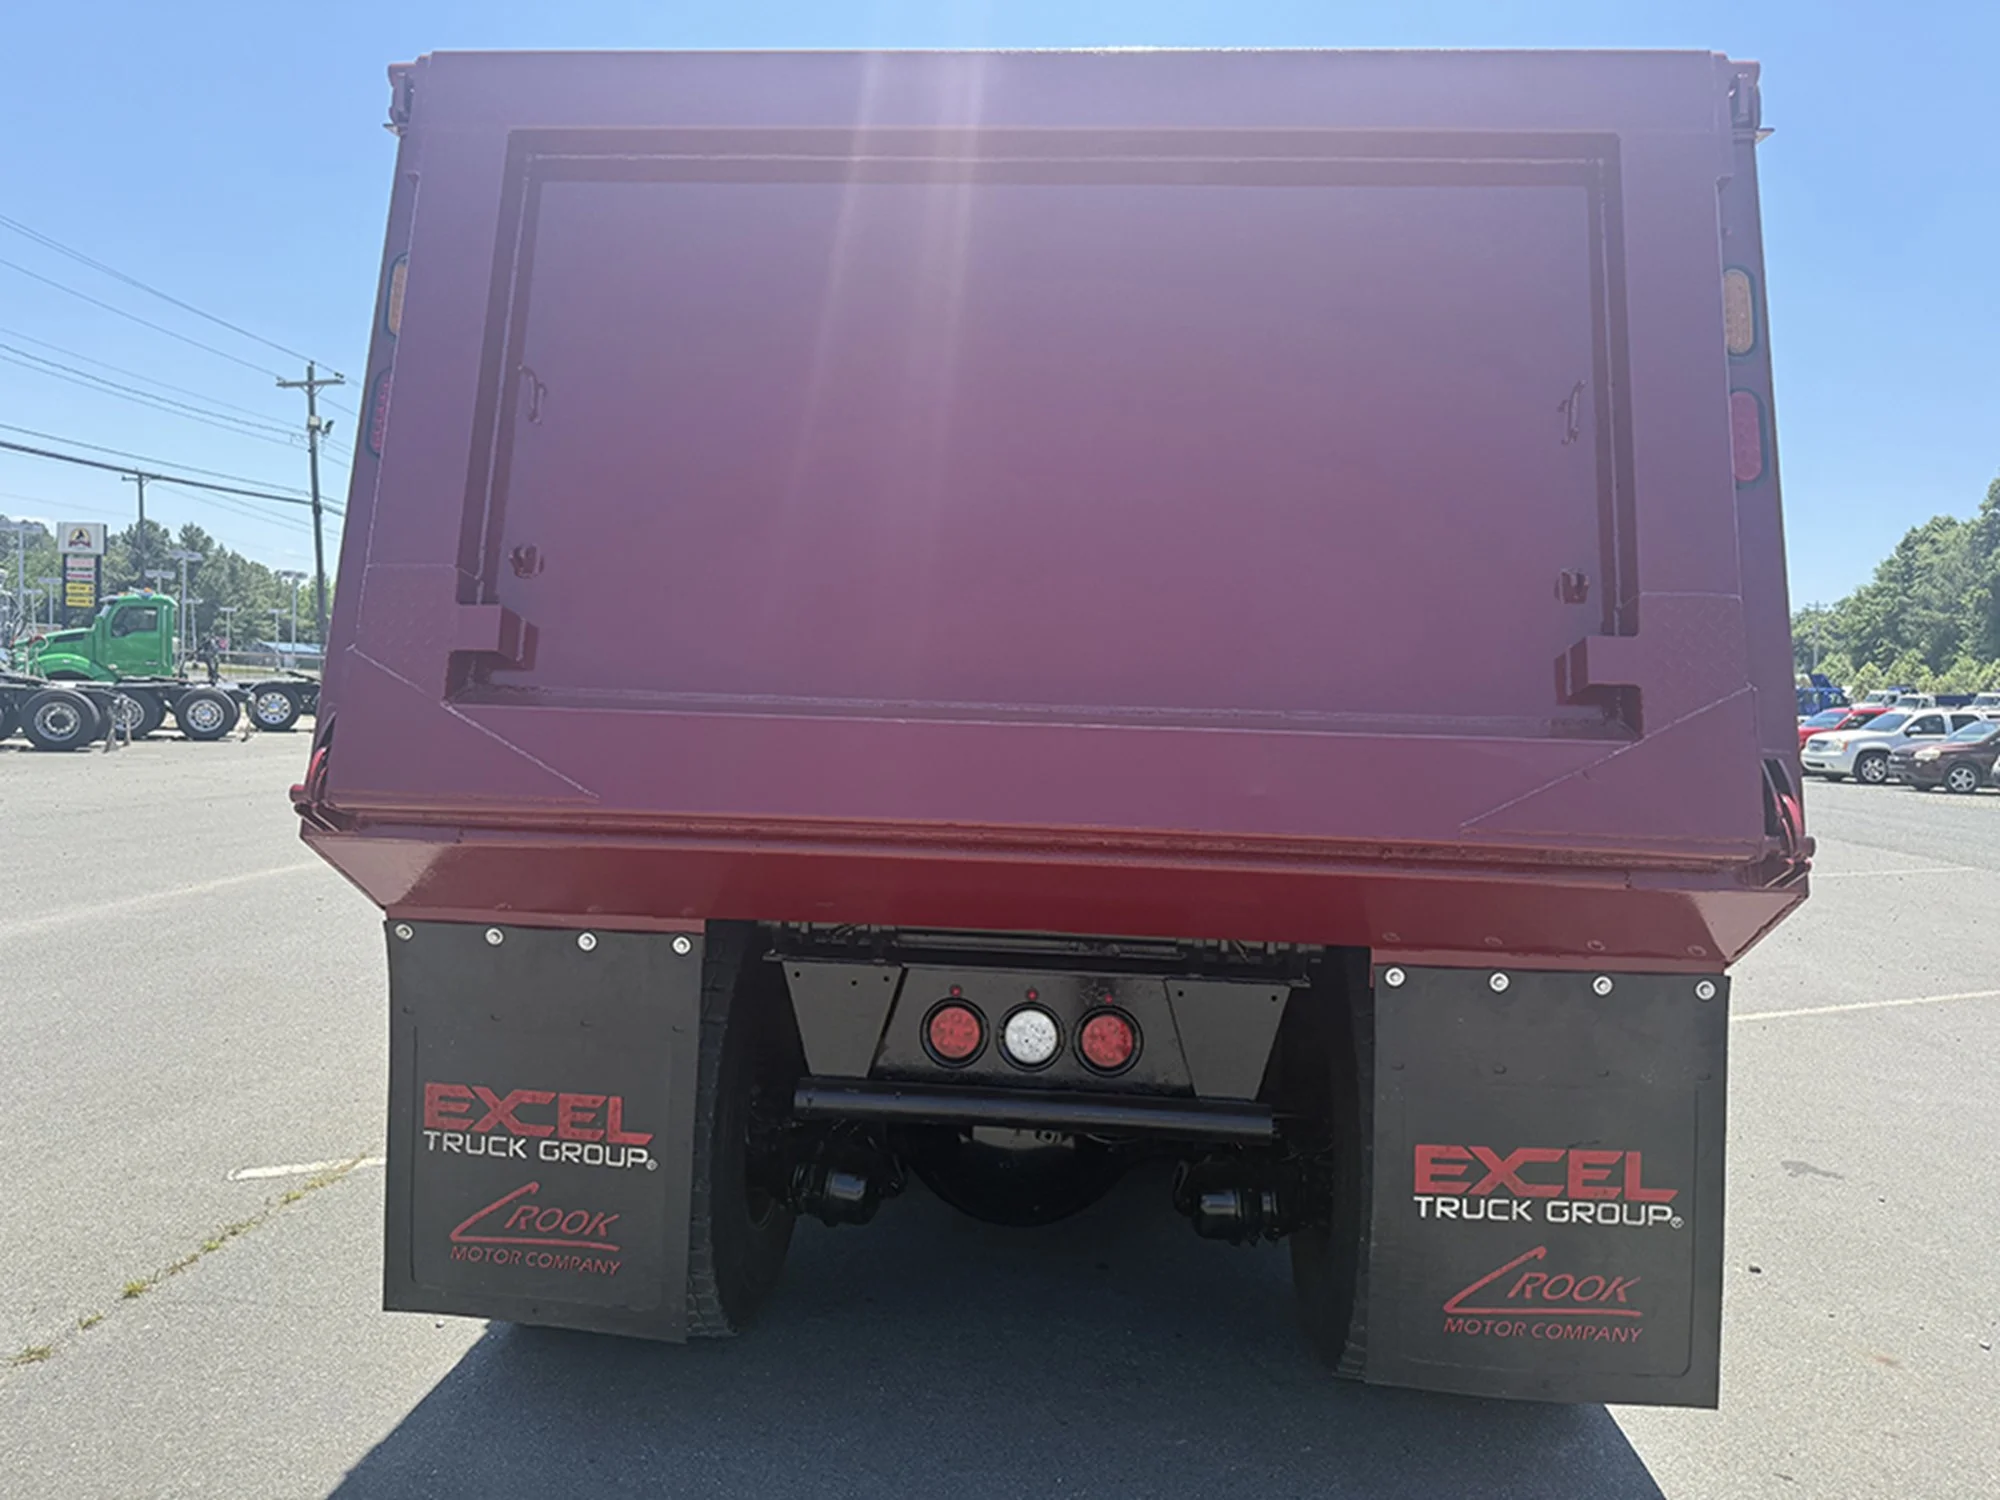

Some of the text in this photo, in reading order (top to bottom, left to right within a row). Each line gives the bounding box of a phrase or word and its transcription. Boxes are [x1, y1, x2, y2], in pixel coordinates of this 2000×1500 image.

[424, 1082, 653, 1145] EXCEL
[423, 1130, 527, 1159] TRUCK
[1414, 1144, 1679, 1202] EXCEL
[1413, 1196, 1533, 1222] TRUCK
[450, 1246, 621, 1275] MOTOR COMPANY
[1444, 1318, 1643, 1343] MOTOR COMPANY
